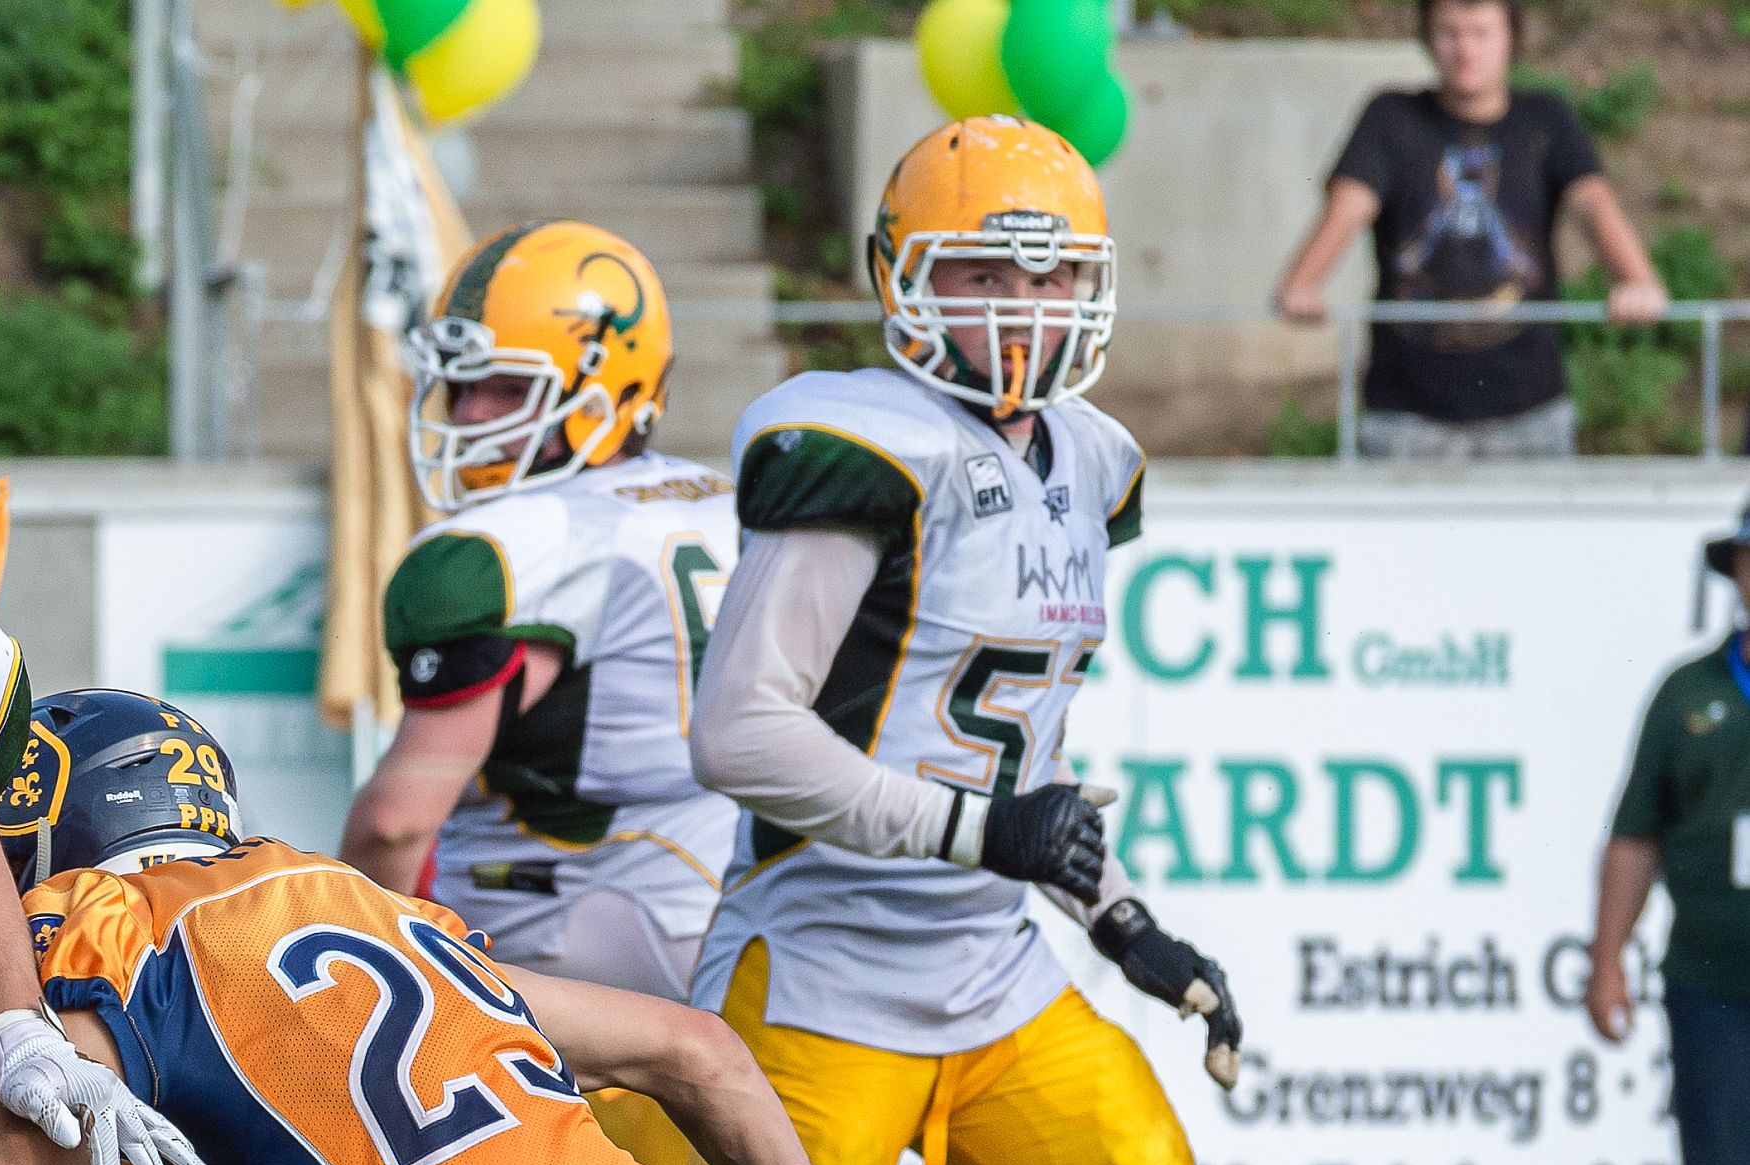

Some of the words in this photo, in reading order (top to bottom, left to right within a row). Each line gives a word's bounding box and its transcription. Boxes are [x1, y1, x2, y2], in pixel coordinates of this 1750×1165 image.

[159, 738, 225, 792] 29
[179, 804, 229, 837] PPP
[1298, 936, 1520, 1006] Estrich
[1564, 1050, 1598, 1122] 8
